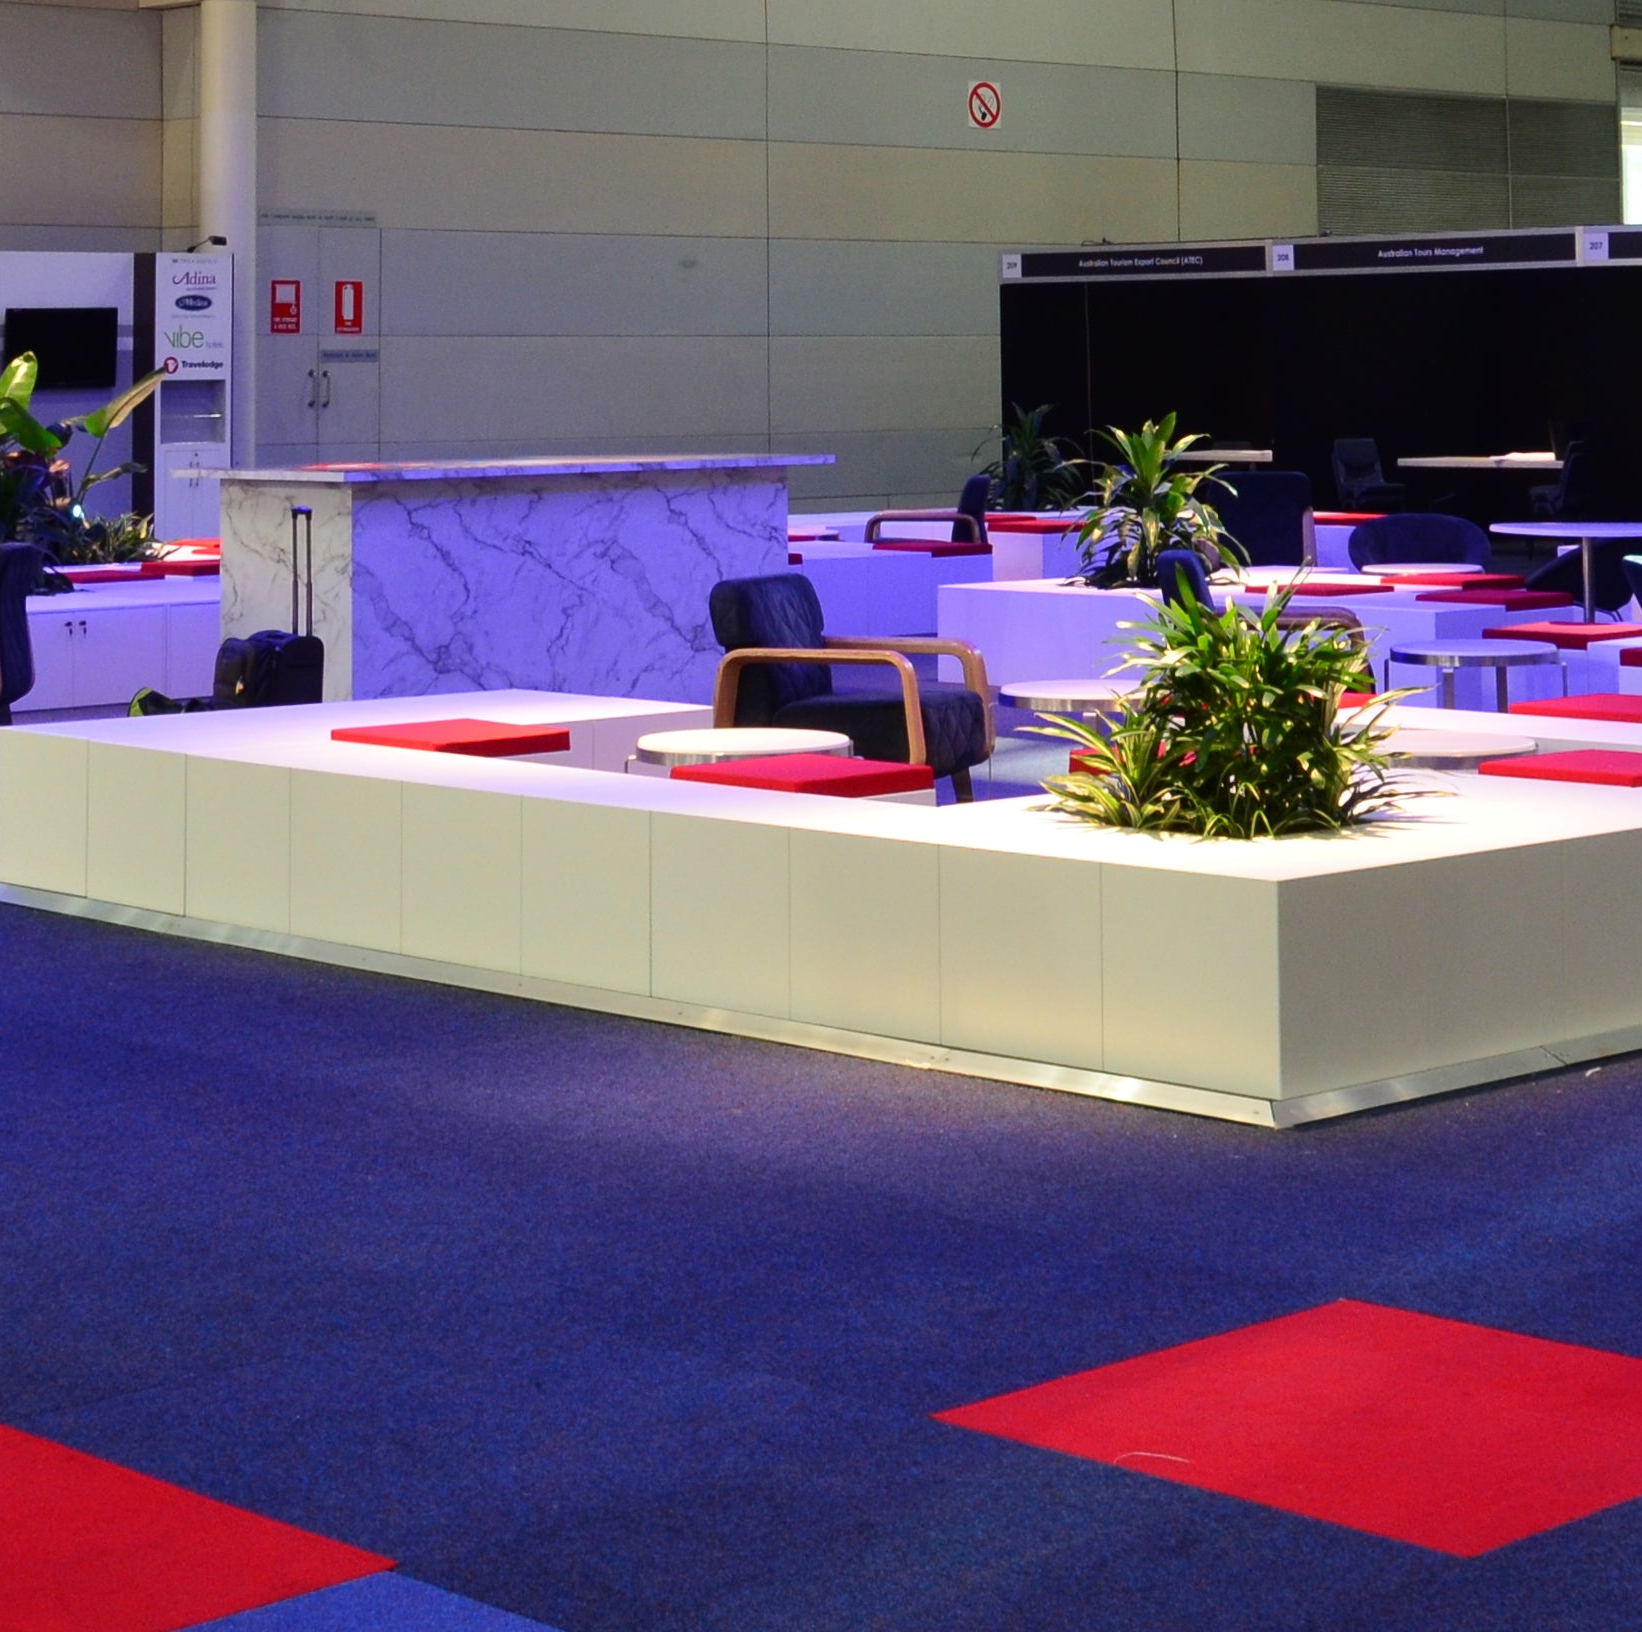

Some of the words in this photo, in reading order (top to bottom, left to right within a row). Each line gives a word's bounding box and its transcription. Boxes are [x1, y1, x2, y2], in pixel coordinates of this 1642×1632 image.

[1378, 248, 1413, 258] Australian
[1414, 247, 1433, 257] Tours
[1434, 246, 1484, 257] Management
[1079, 258, 1109, 268] Australian
[1110, 257, 1133, 267] Tourism
[1134, 256, 1154, 267] Export
[1155, 255, 1180, 266] Council
[1181, 255, 1203, 266] (ATEC)
[172, 271, 216, 285] Adina
[164, 324, 204, 349] vibe
[181, 359, 224, 370] Travelodge
